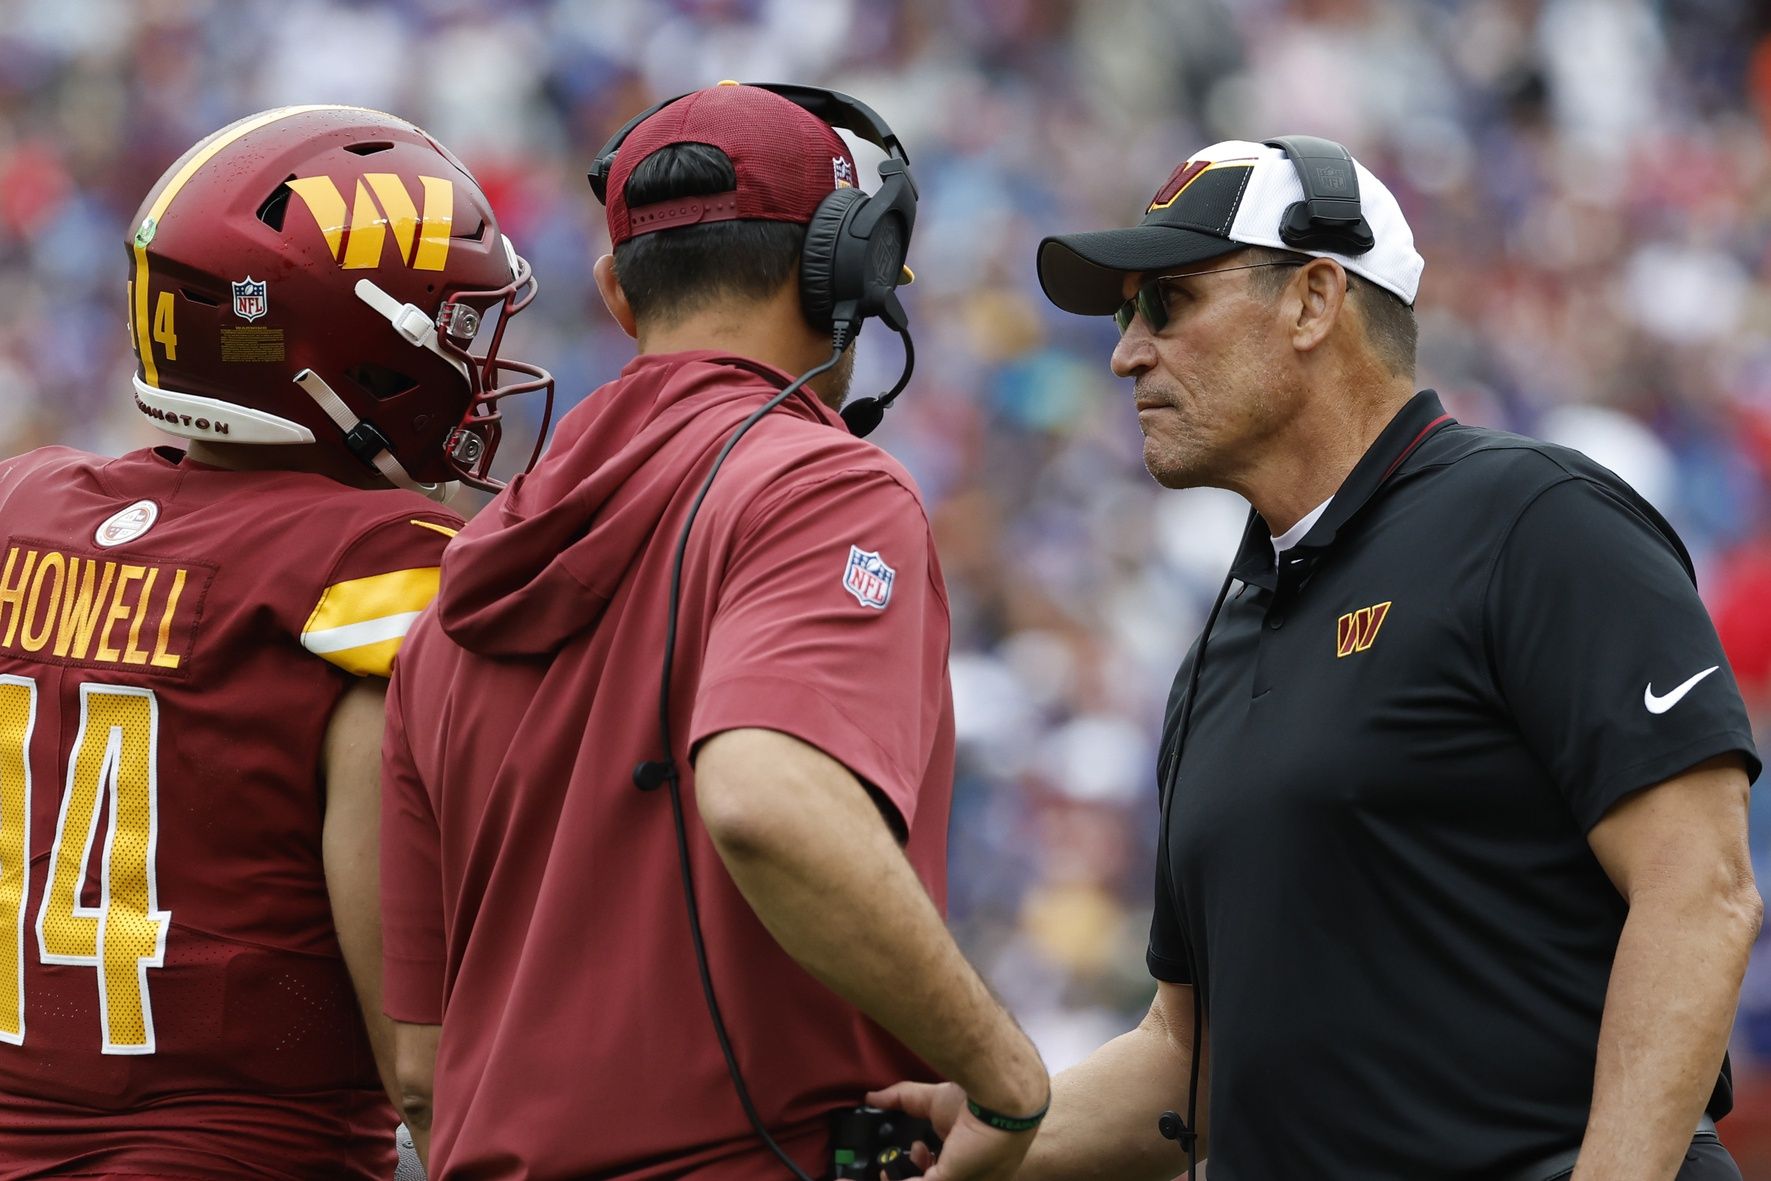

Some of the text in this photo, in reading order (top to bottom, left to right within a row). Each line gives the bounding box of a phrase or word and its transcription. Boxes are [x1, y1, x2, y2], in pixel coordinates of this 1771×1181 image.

[284, 173, 453, 271] W
[239, 297, 262, 314] NFL
[0, 547, 187, 669] HOWELL
[850, 567, 883, 602] NFL
[1337, 601, 1392, 657] W
[0, 674, 171, 1054] 14
